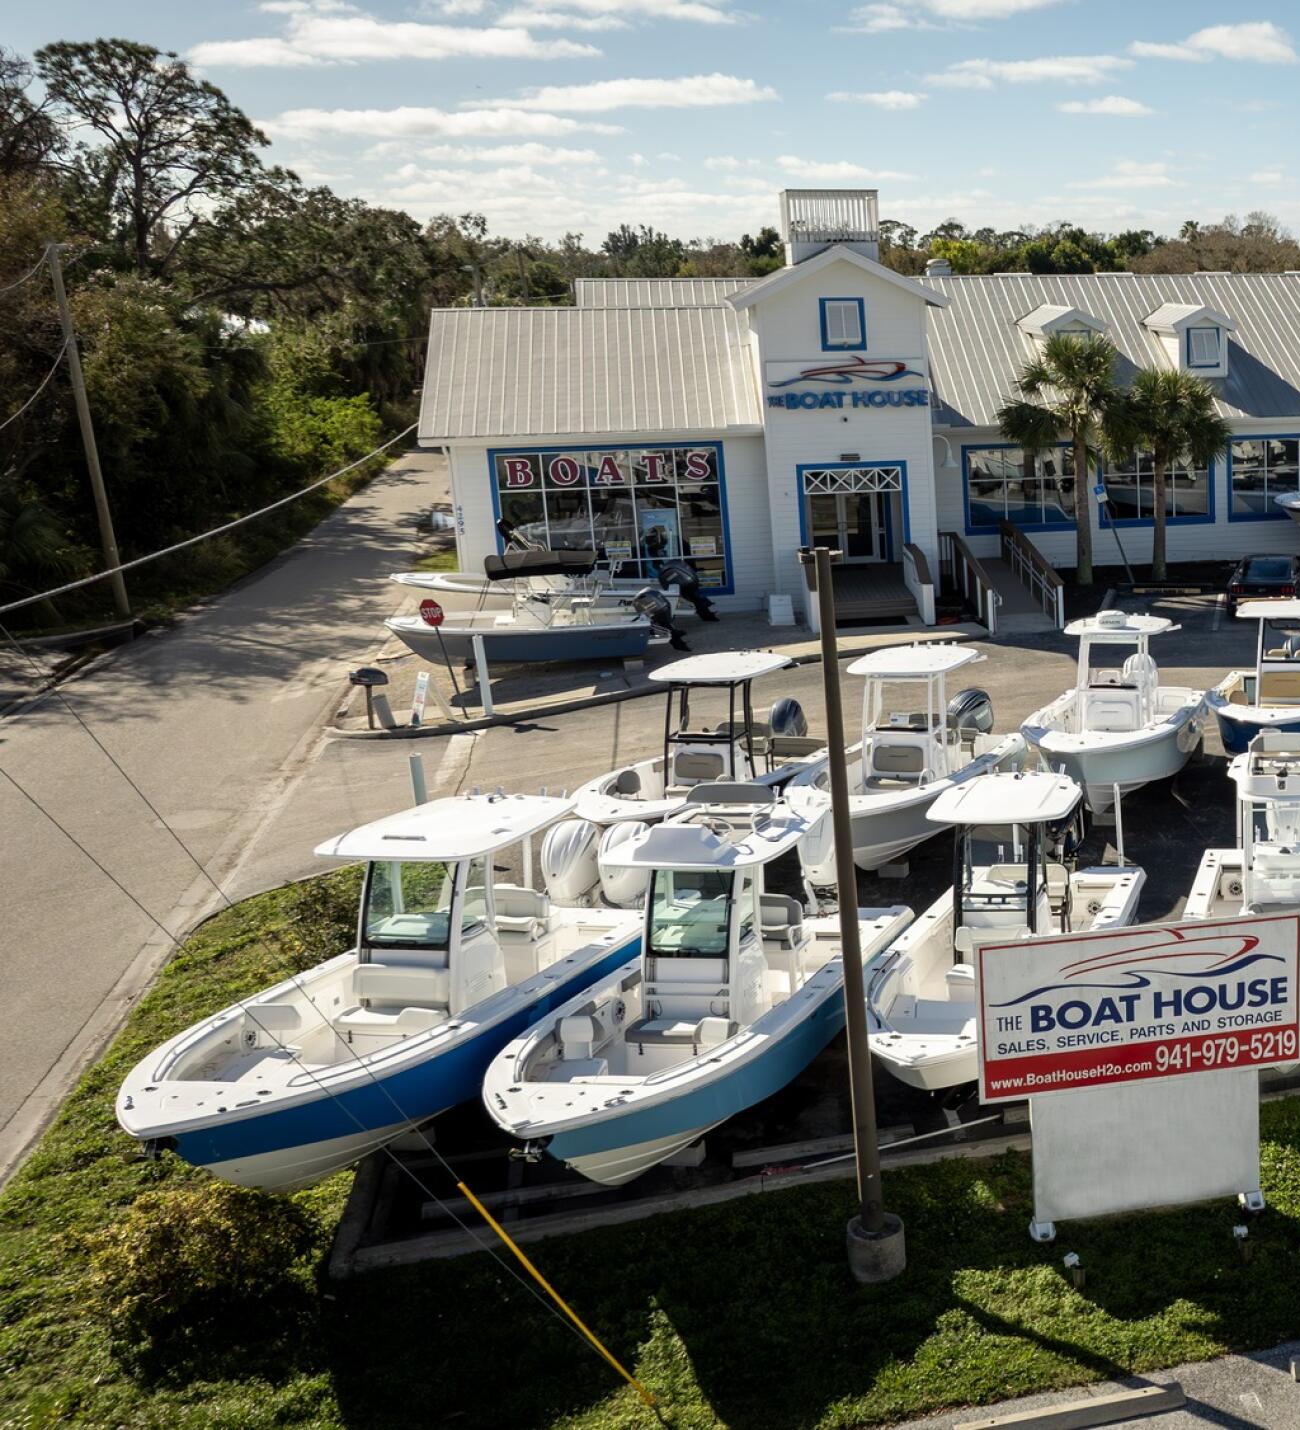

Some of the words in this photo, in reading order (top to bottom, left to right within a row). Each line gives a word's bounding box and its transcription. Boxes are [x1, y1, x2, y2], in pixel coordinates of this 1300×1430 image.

[767, 395, 785, 409] THE
[785, 391, 846, 410] BOAT
[852, 389, 929, 408] HOUSE
[504, 452, 711, 487] BOATS
[421, 607, 441, 619] STOP
[996, 1015, 1022, 1032] THE
[1030, 993, 1141, 1033] BOAT
[1153, 976, 1288, 1019] HOUSE
[997, 1038, 1050, 1055] SALES,
[1056, 1030, 1123, 1048] SERVICE,
[1130, 1023, 1175, 1040] PARTS
[1181, 1019, 1211, 1033] AND
[1217, 1010, 1282, 1029] STORAGE
[991, 1061, 1151, 1090] www.BoatHouseH2o.com
[1155, 1029, 1296, 1072] 941-979-5219
